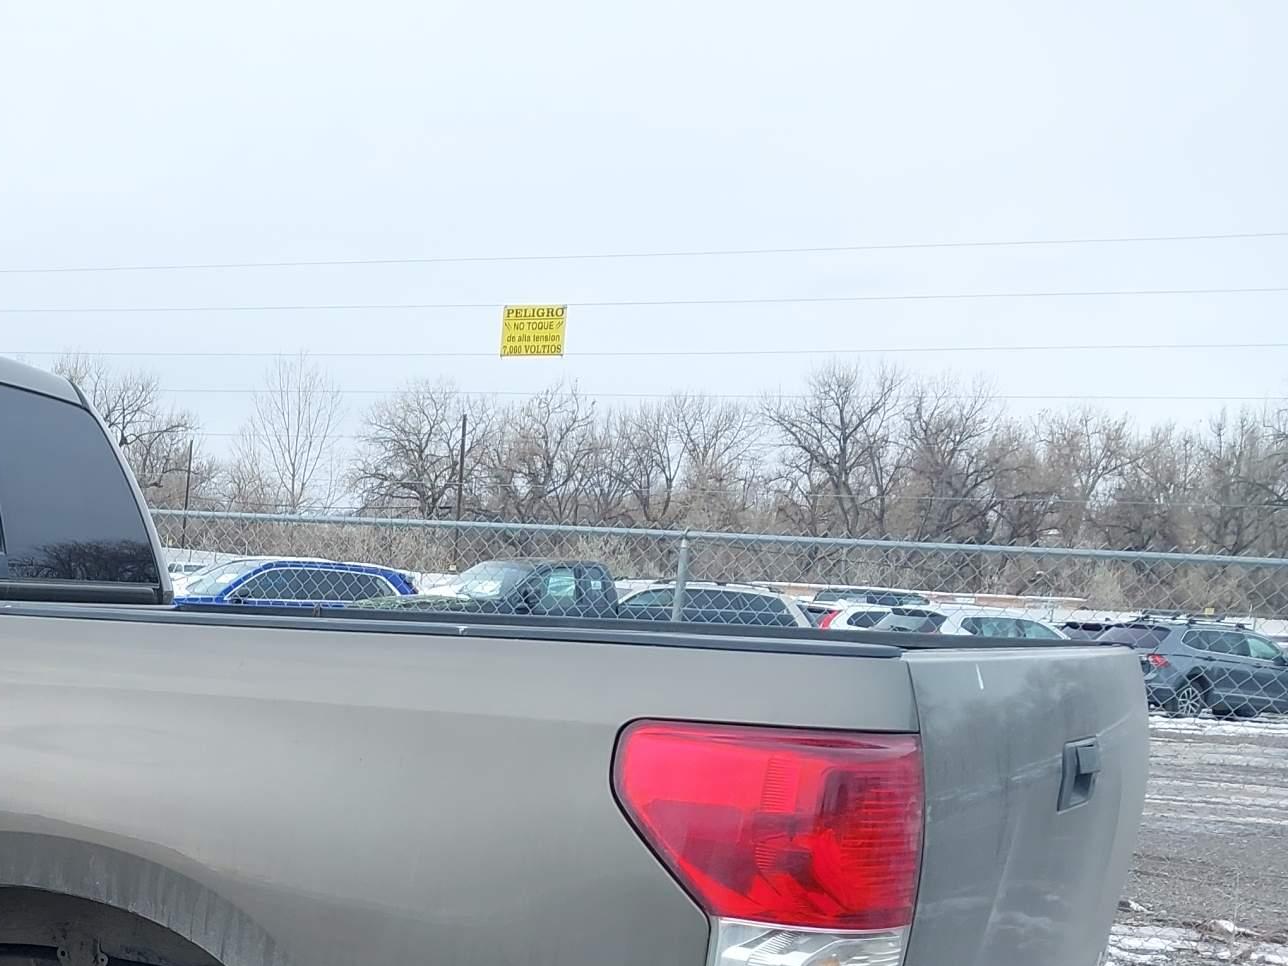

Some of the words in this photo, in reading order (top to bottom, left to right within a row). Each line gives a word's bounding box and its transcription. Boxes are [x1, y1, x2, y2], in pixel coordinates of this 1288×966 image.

[506, 307, 565, 318] PELIGRO
[513, 321, 525, 331] NO
[527, 320, 554, 331] TOQUE
[506, 334, 516, 343] de
[518, 333, 531, 343] alta
[524, 344, 562, 354] VOLTIOS
